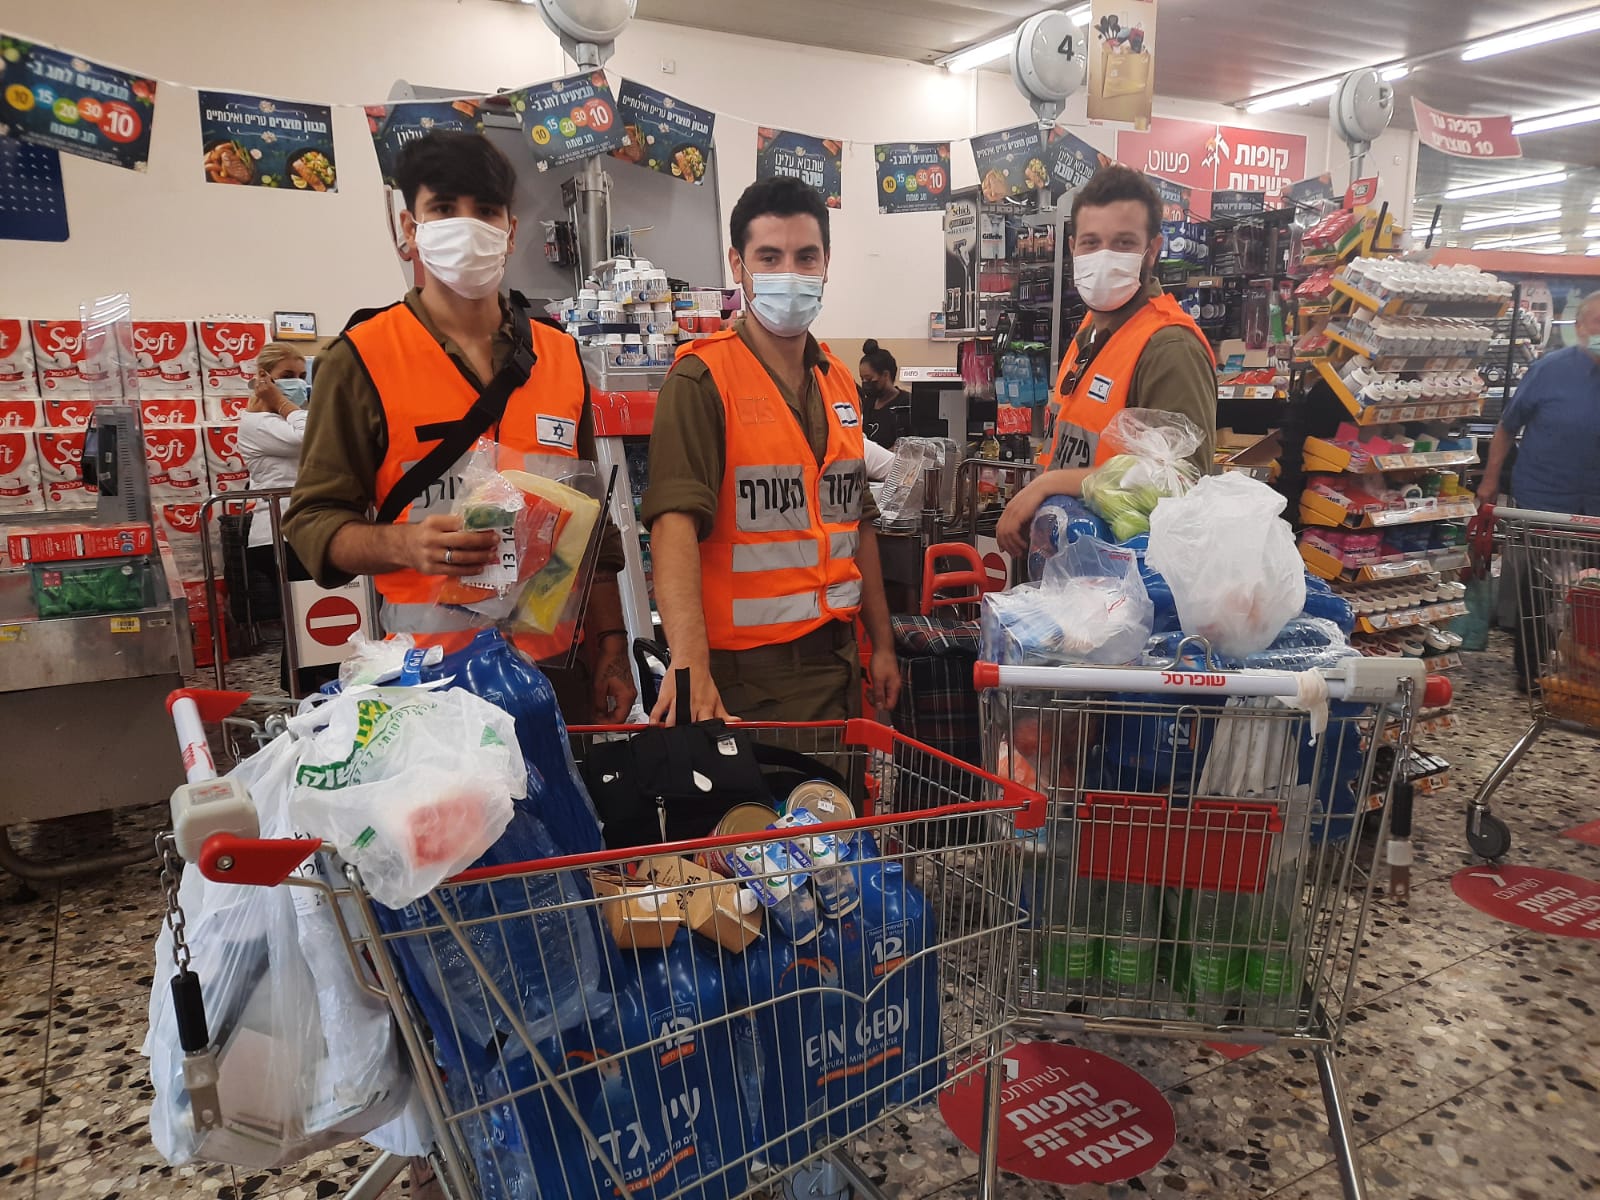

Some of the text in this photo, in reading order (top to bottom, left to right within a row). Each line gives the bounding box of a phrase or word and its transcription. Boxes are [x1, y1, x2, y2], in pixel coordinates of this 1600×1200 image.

[1057, 35, 1074, 61] 4
[46, 67, 74, 86] לחג
[76, 73, 129, 100] מבצעים
[543, 94, 560, 110] לחג
[560, 85, 594, 103] מבצעים
[14, 88, 134, 137] 10 15 20 30 10
[206, 109, 327, 134] מגוון מוצרים טריים ואיכותיים
[536, 105, 610, 141] 10 15 20 30 10
[622, 94, 709, 135] מגוון מוצרים טריים ואיכותיים
[1429, 112, 1482, 137] קופה עד
[49, 122, 97, 144] חג שמח
[565, 134, 594, 150] חג שמח
[1007, 138, 1026, 151] מוצרים
[1025, 134, 1039, 148] מגוון
[1431, 132, 1494, 155] 10 מוצרים
[774, 152, 825, 172] שתבוא עלינו
[898, 153, 912, 165] לחג
[912, 153, 938, 165] מבצעים
[1057, 149, 1094, 177] שתבוא עלינו
[1234, 143, 1290, 176] קופות
[885, 172, 943, 189] 10 15 20 30 10
[905, 193, 928, 202] חג שמח
[47, 326, 86, 357] Sof
[134, 328, 177, 356] Soft
[213, 328, 256, 356] Soft
[0, 406, 24, 428] oft
[53, 439, 84, 465] So
[144, 435, 185, 461] Soft
[739, 478, 804, 520] העורף
[171, 507, 202, 528] Sof
[501, 526, 514, 544] 14
[502, 552, 516, 570] 13
[1160, 671, 1226, 687] שופרסל
[1168, 722, 1190, 746] 12
[1515, 886, 1580, 914] קופות
[871, 936, 904, 964] 12
[658, 1017, 695, 1052] 12
[805, 1023, 845, 1068] EIN
[854, 997, 911, 1047] GEDI
[661, 1086, 701, 1142] עין
[1004, 1081, 1101, 1132] קופות
[1021, 1098, 1143, 1159] בשירות
[1064, 1124, 1155, 1169] עצמי
